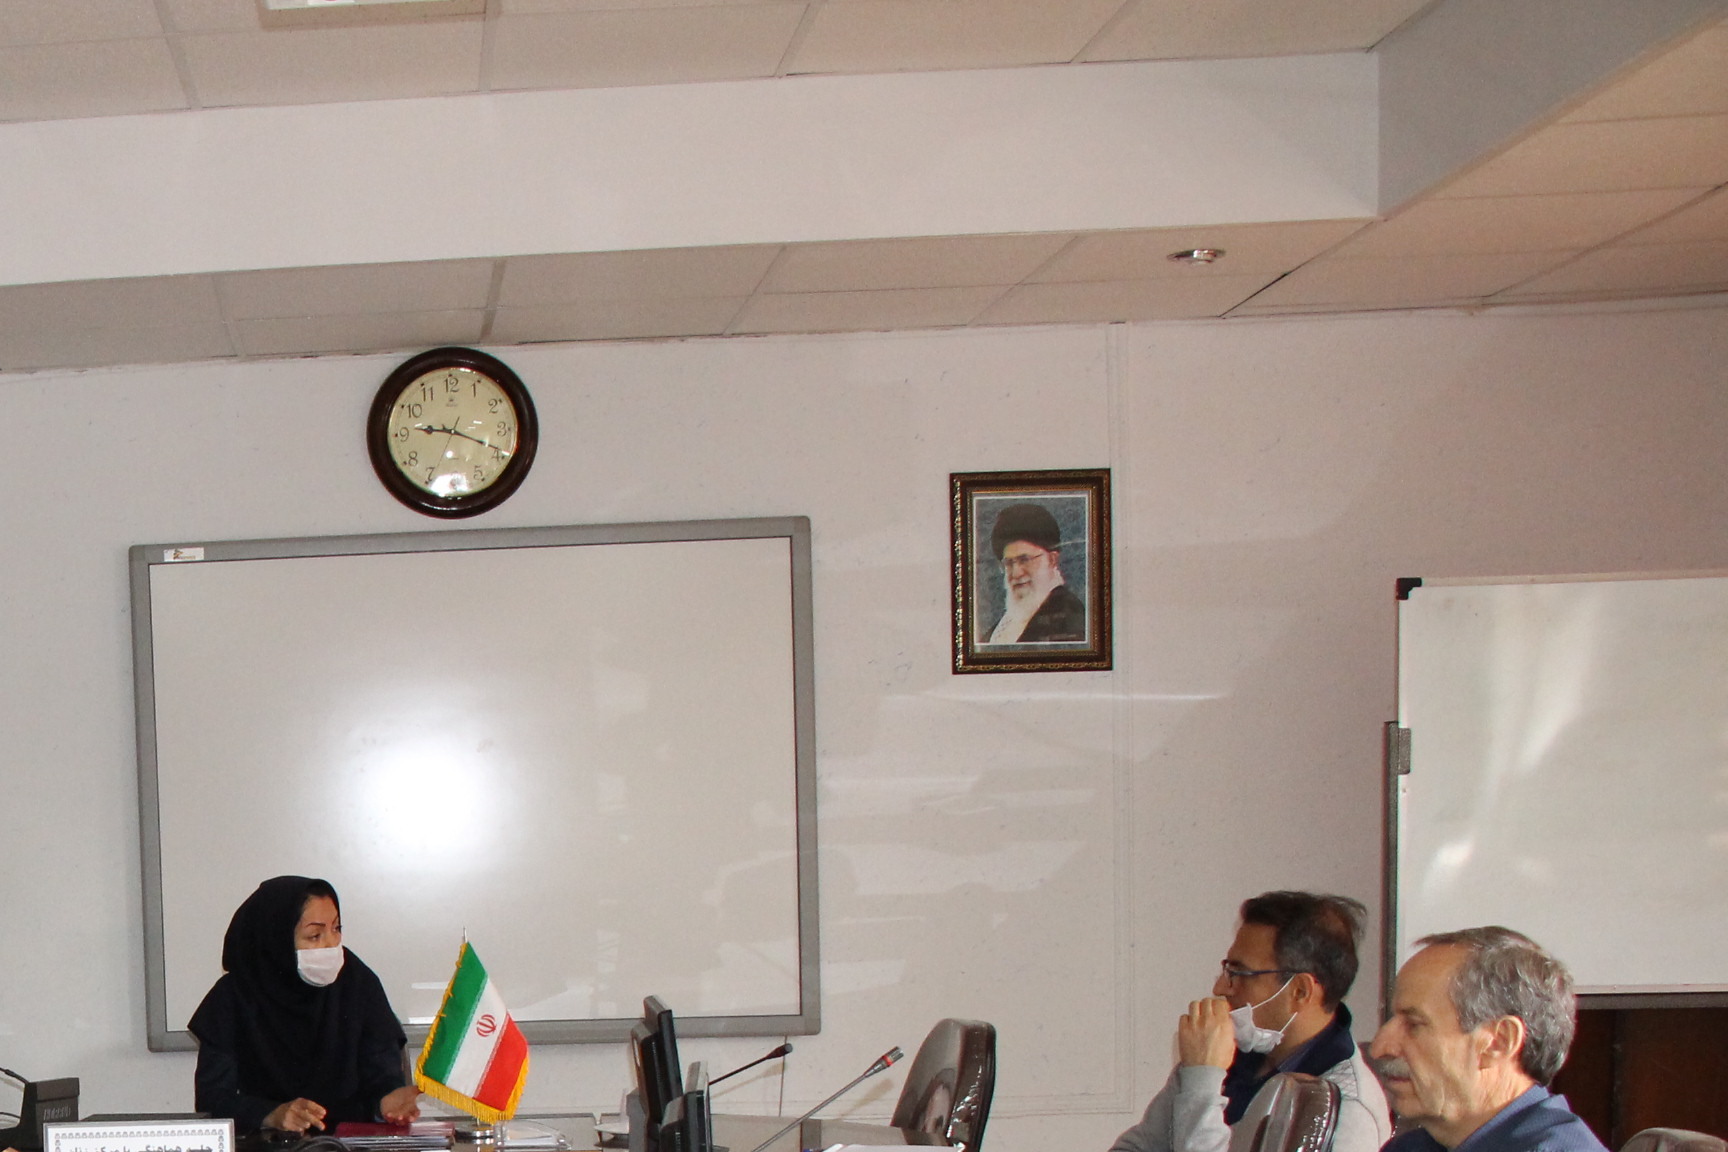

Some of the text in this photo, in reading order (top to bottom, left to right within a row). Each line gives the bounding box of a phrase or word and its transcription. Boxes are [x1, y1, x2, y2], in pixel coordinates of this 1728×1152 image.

[444, 377, 460, 393] 12
[471, 382, 477, 398] 1
[422, 386, 434, 402] 11
[407, 403, 423, 418] 10
[488, 398, 499, 414] 2
[399, 427, 410, 442] 9
[497, 422, 507, 437] 3
[408, 451, 418, 466] 8
[425, 467, 435, 482] 7
[473, 465, 483, 480] 5
